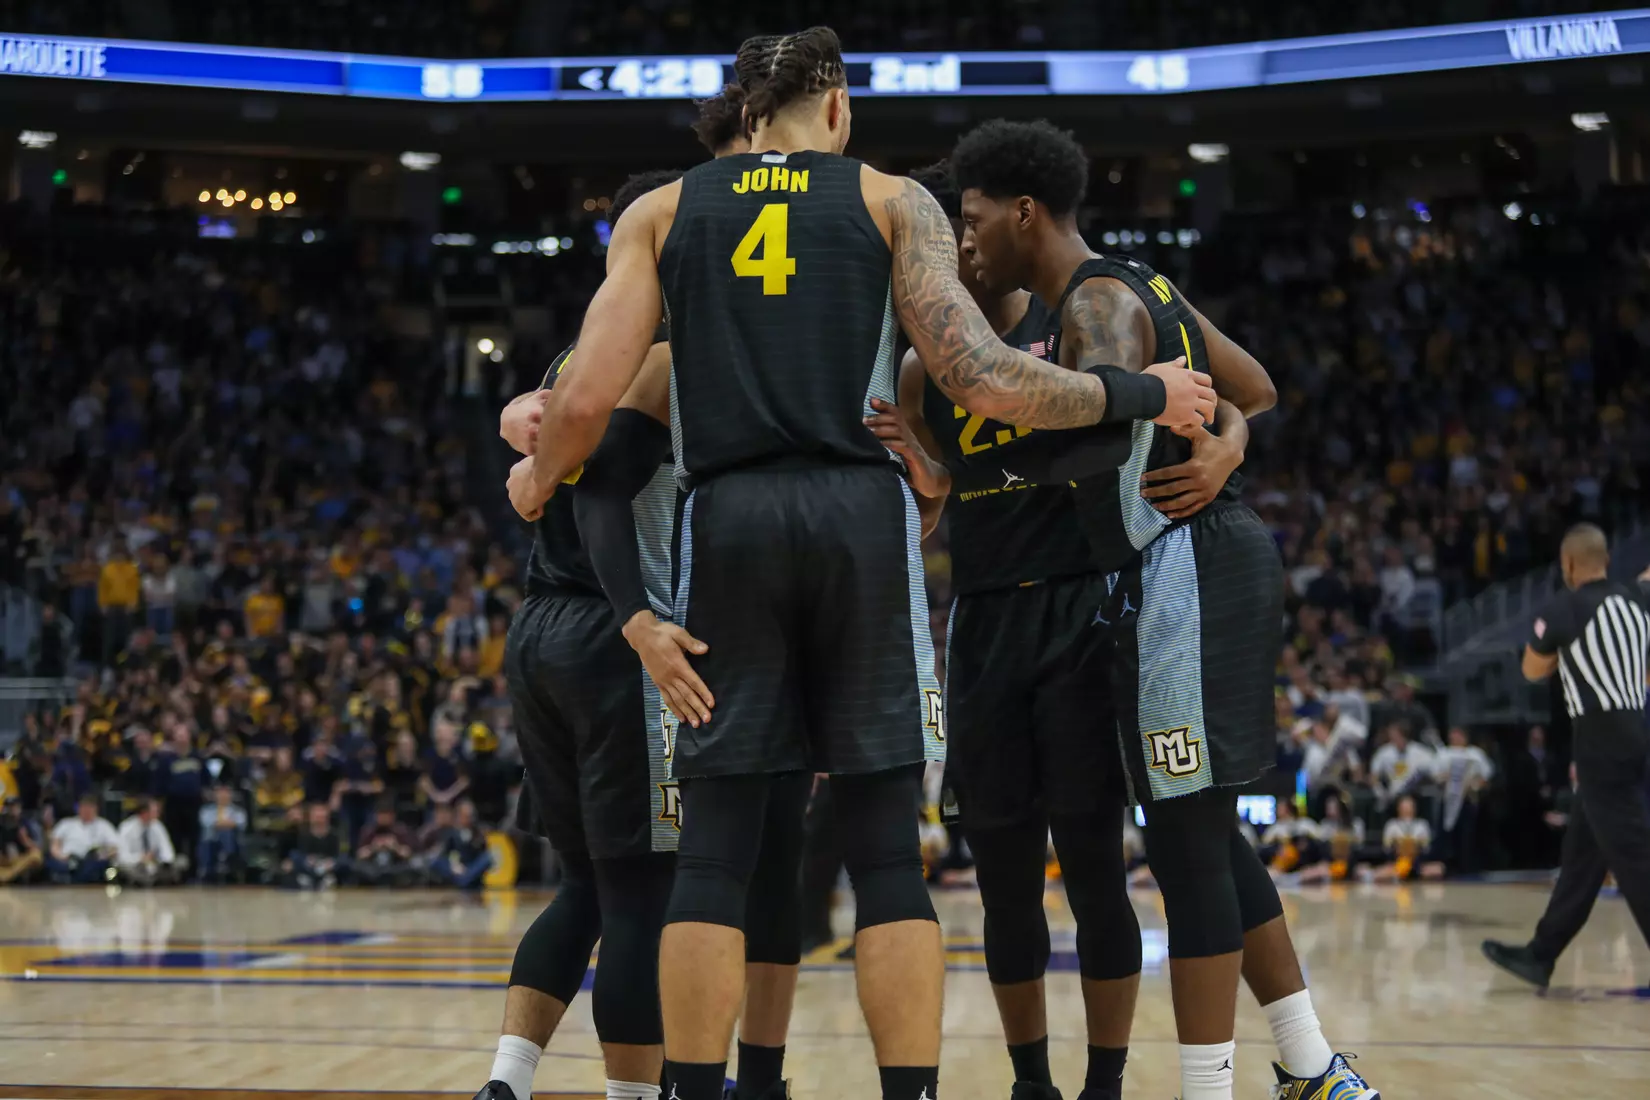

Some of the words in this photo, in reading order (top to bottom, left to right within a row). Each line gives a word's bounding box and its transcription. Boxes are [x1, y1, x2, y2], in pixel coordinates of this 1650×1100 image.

[1505, 18, 1622, 60] VILLANOVA
[870, 54, 961, 92] 2nd
[1126, 54, 1189, 90] 45
[732, 166, 810, 194] JOHN
[730, 202, 796, 296] 4
[1145, 724, 1202, 778] MU
